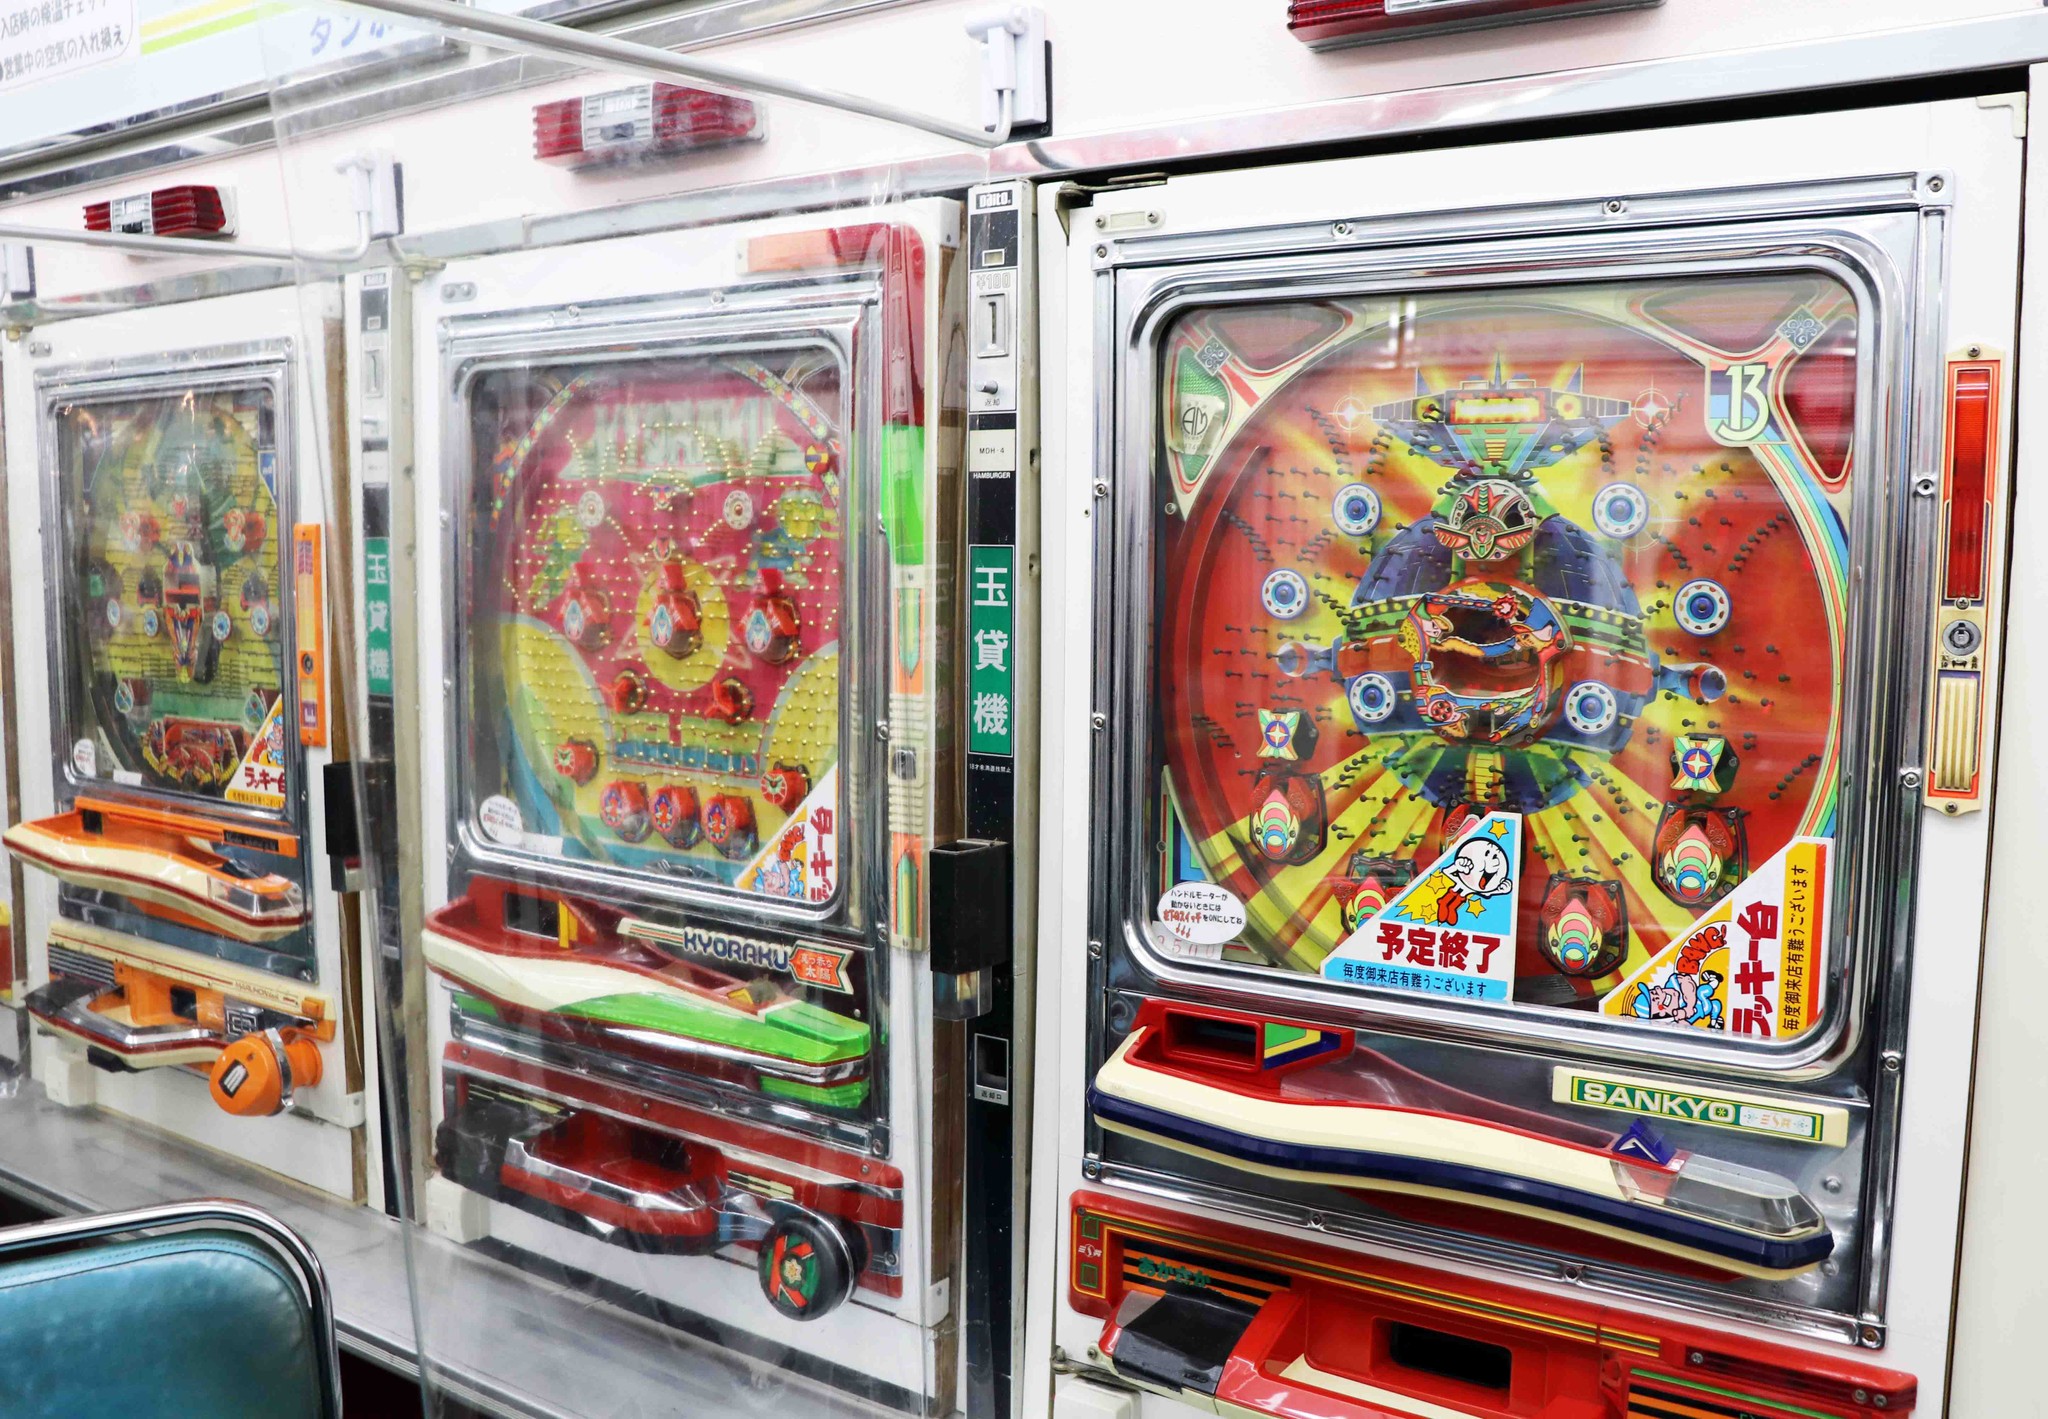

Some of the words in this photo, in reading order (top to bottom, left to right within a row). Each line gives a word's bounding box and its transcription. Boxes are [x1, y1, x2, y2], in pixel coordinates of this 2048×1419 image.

[1715, 363, 1769, 441] 13
[973, 567, 1009, 736] 玉貸機
[1171, 890, 1228, 901] ハンドルモーターが
[684, 930, 790, 971] KYORAKU
[1376, 922, 1501, 974] 予定終了
[1676, 924, 1728, 975] BANG!
[1732, 900, 1779, 1037] ラッキー台
[1782, 864, 1809, 1031] 毎度御来店有難うございます
[1343, 962, 1487, 997] 毎度御来店有難うございます
[1583, 1081, 1736, 1124] SANKYO
[1138, 1256, 1211, 1288] あかさか
